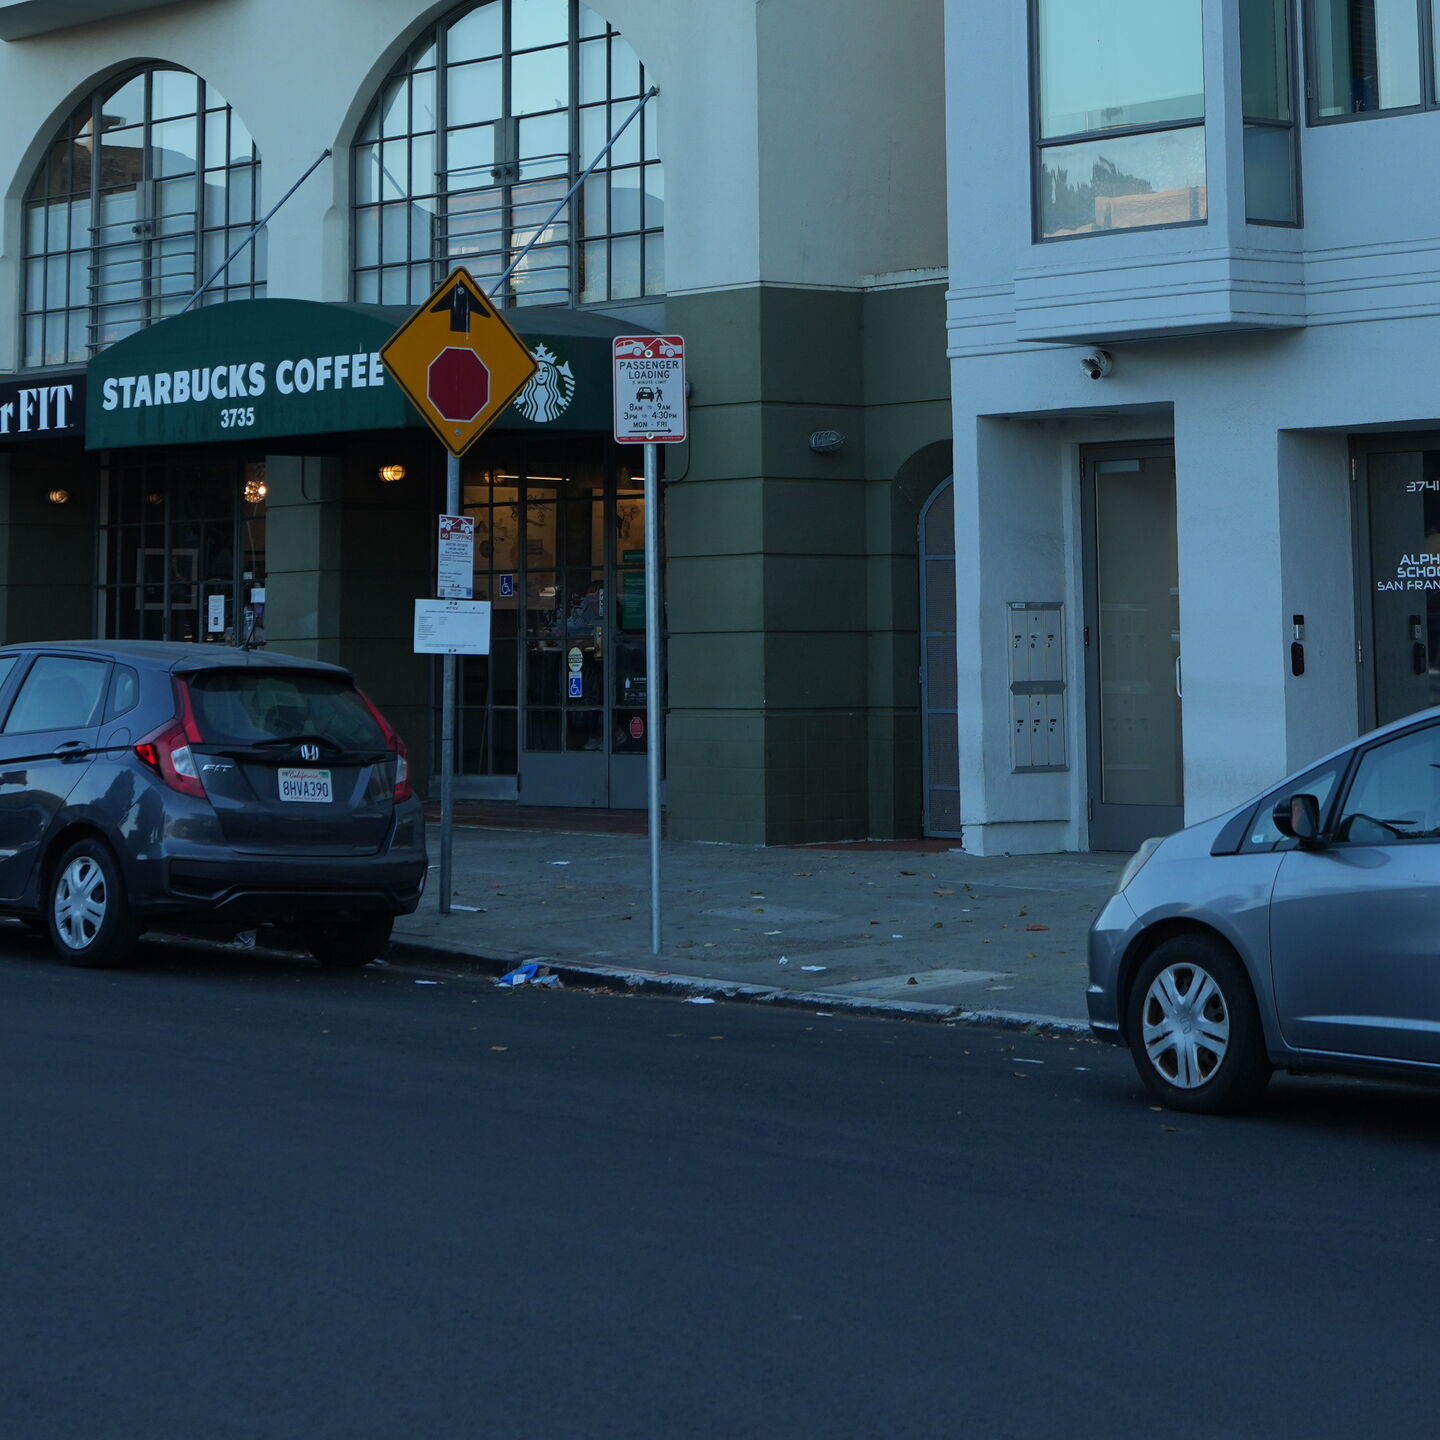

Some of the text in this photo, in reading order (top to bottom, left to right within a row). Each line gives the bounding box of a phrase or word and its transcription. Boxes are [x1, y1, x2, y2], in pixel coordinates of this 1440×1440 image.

[619, 361, 679, 370] PASSENGER
[628, 370, 670, 380] LOADING
[102, 352, 385, 411] STARBUCKS COFFEE
[18, 384, 73, 433] FIT
[629, 403, 643, 411] 8AM
[657, 402, 671, 410] 9AM
[220, 407, 255, 429] 3735
[624, 411, 638, 420] 3PM
[652, 411, 678, 419] 4:30PM
[1406, 480, 1440, 492] 3741
[1377, 580, 1403, 591] SAN
[283, 780, 329, 798] 8HVA390
